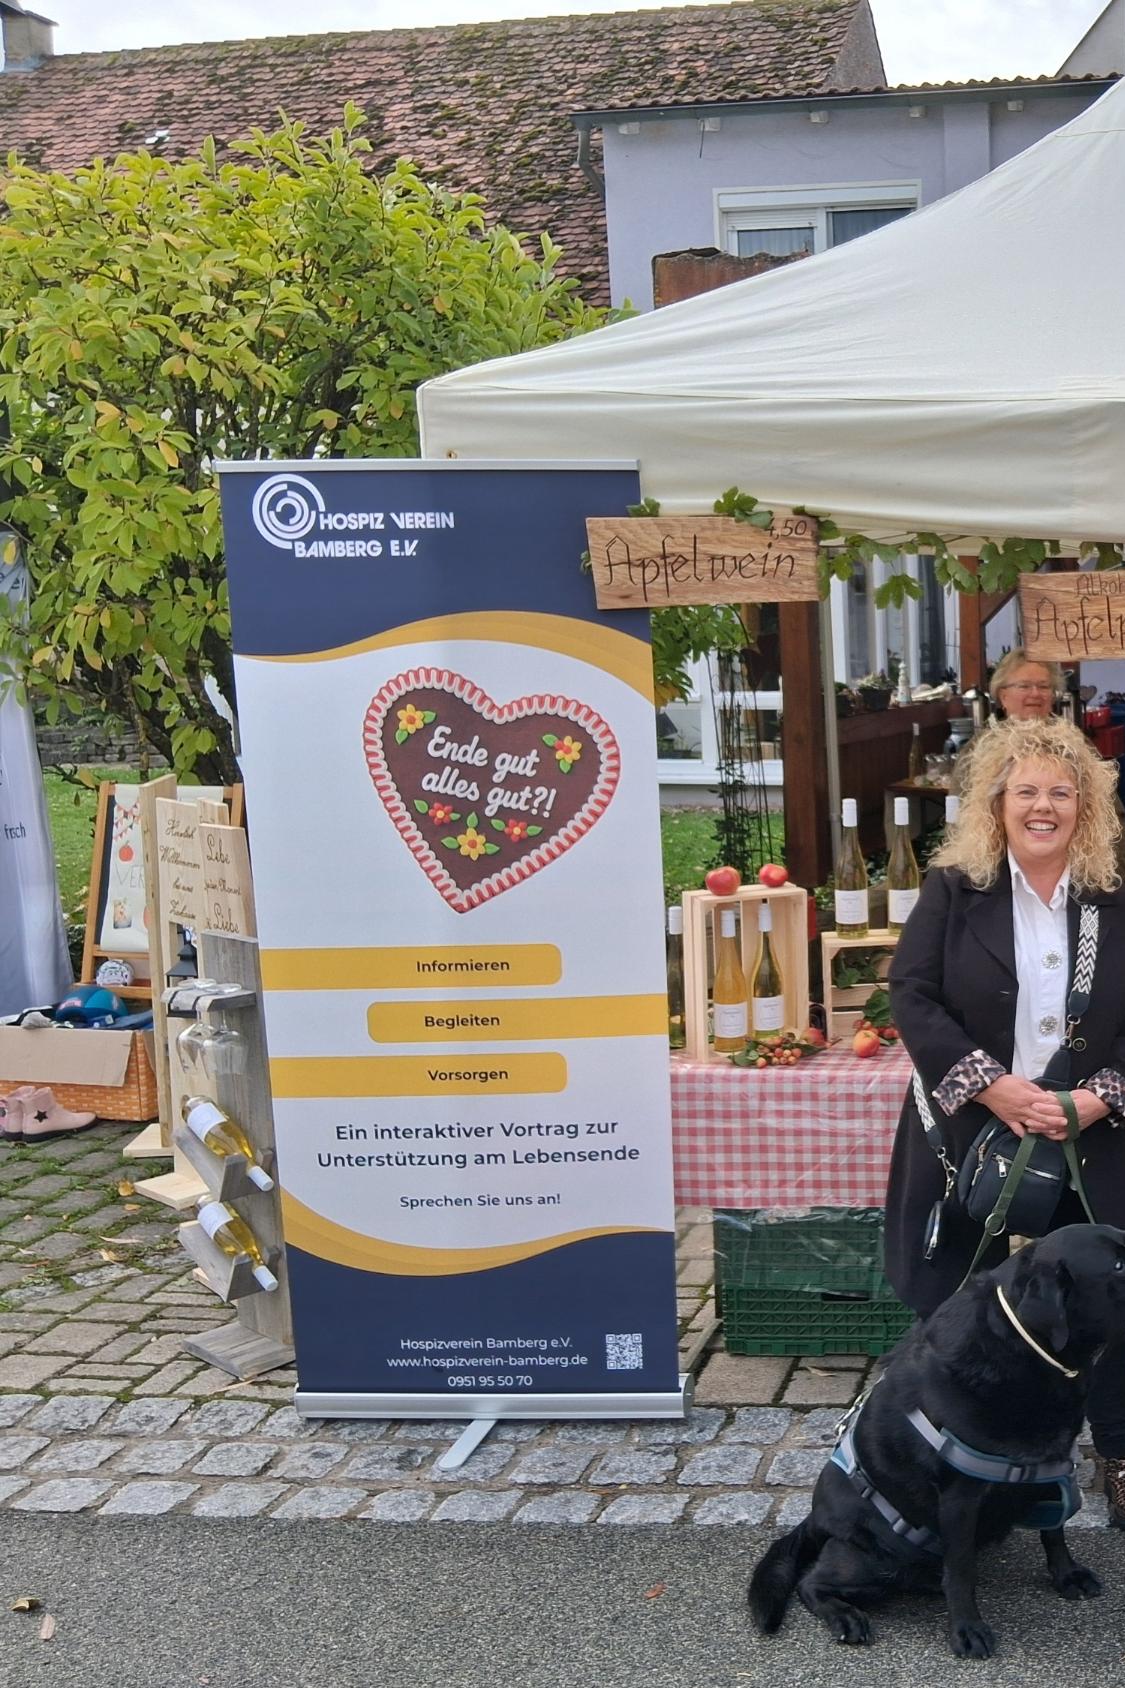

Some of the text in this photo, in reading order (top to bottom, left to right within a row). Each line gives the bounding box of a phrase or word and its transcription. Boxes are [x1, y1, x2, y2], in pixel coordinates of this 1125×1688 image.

[319, 511, 456, 531] HOSPIZ VEREIN
[293, 539, 419, 558] BAMBERG E.V.
[603, 534, 796, 603] Apfelwein
[427, 725, 541, 784] Ende gut
[421, 765, 558, 819] alles gut?!
[206, 833, 231, 865] Lebe
[416, 957, 511, 974] Informieren
[424, 1013, 501, 1031] Begleiten
[427, 1067, 509, 1084] Vorsorgen
[335, 1119, 619, 1141] Ein interaktiver Vortrag zur
[317, 1145, 641, 1170] Unterstützung am Lebensende
[399, 1193, 562, 1210] Sprechen Sie uns an!
[400, 1336, 573, 1352] Hospizverein Bamberg e.V.
[387, 1354, 589, 1371] www.hospizverein-bamberg.de
[447, 1375, 534, 1388] 0951 95 50 70
